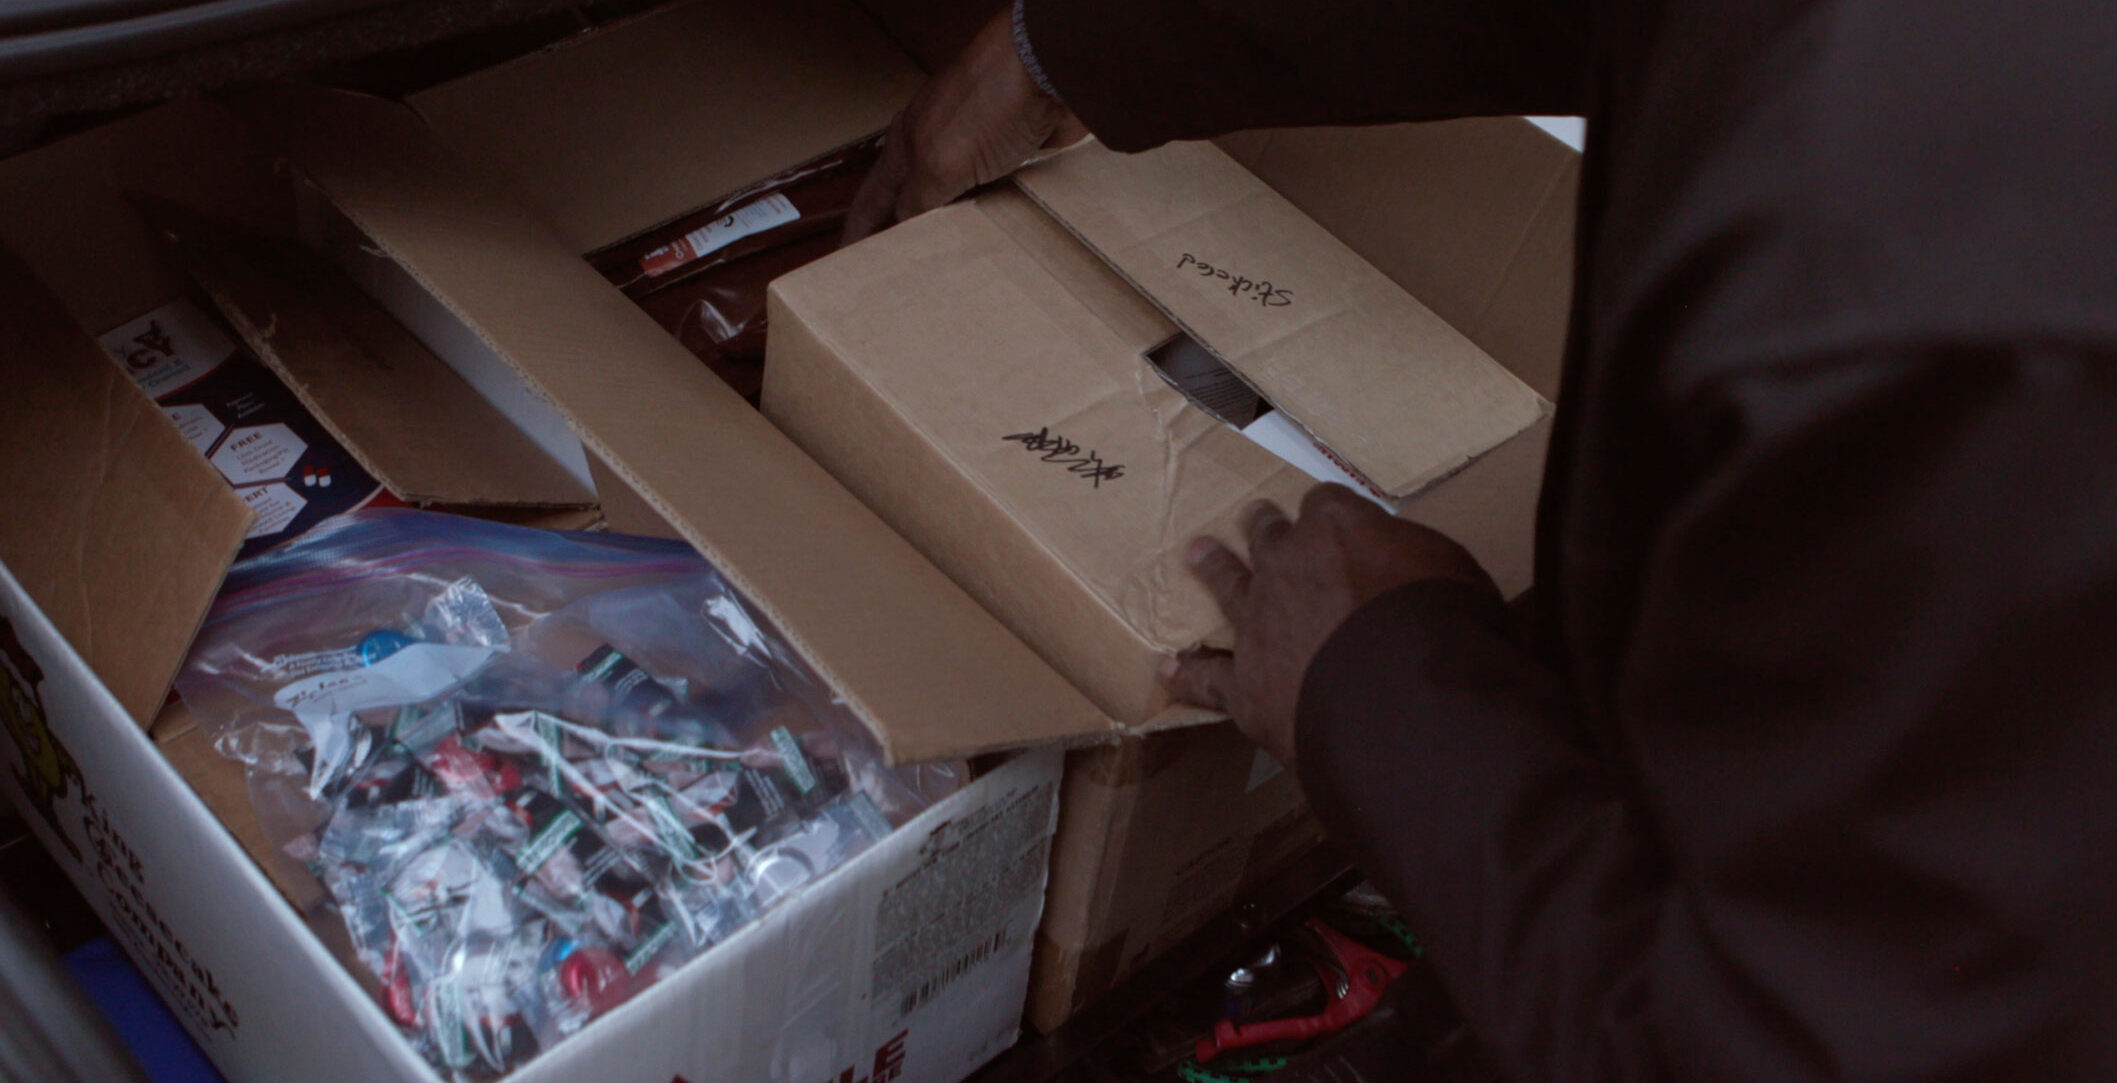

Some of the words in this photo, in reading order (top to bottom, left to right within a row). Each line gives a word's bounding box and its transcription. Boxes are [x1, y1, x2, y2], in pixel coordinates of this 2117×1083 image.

[230, 431, 264, 451] FREE
[244, 486, 270, 502] ERT
[83, 794, 145, 884] King
[83, 815, 240, 1028] Cheesecake
[97, 862, 238, 1041] Company
